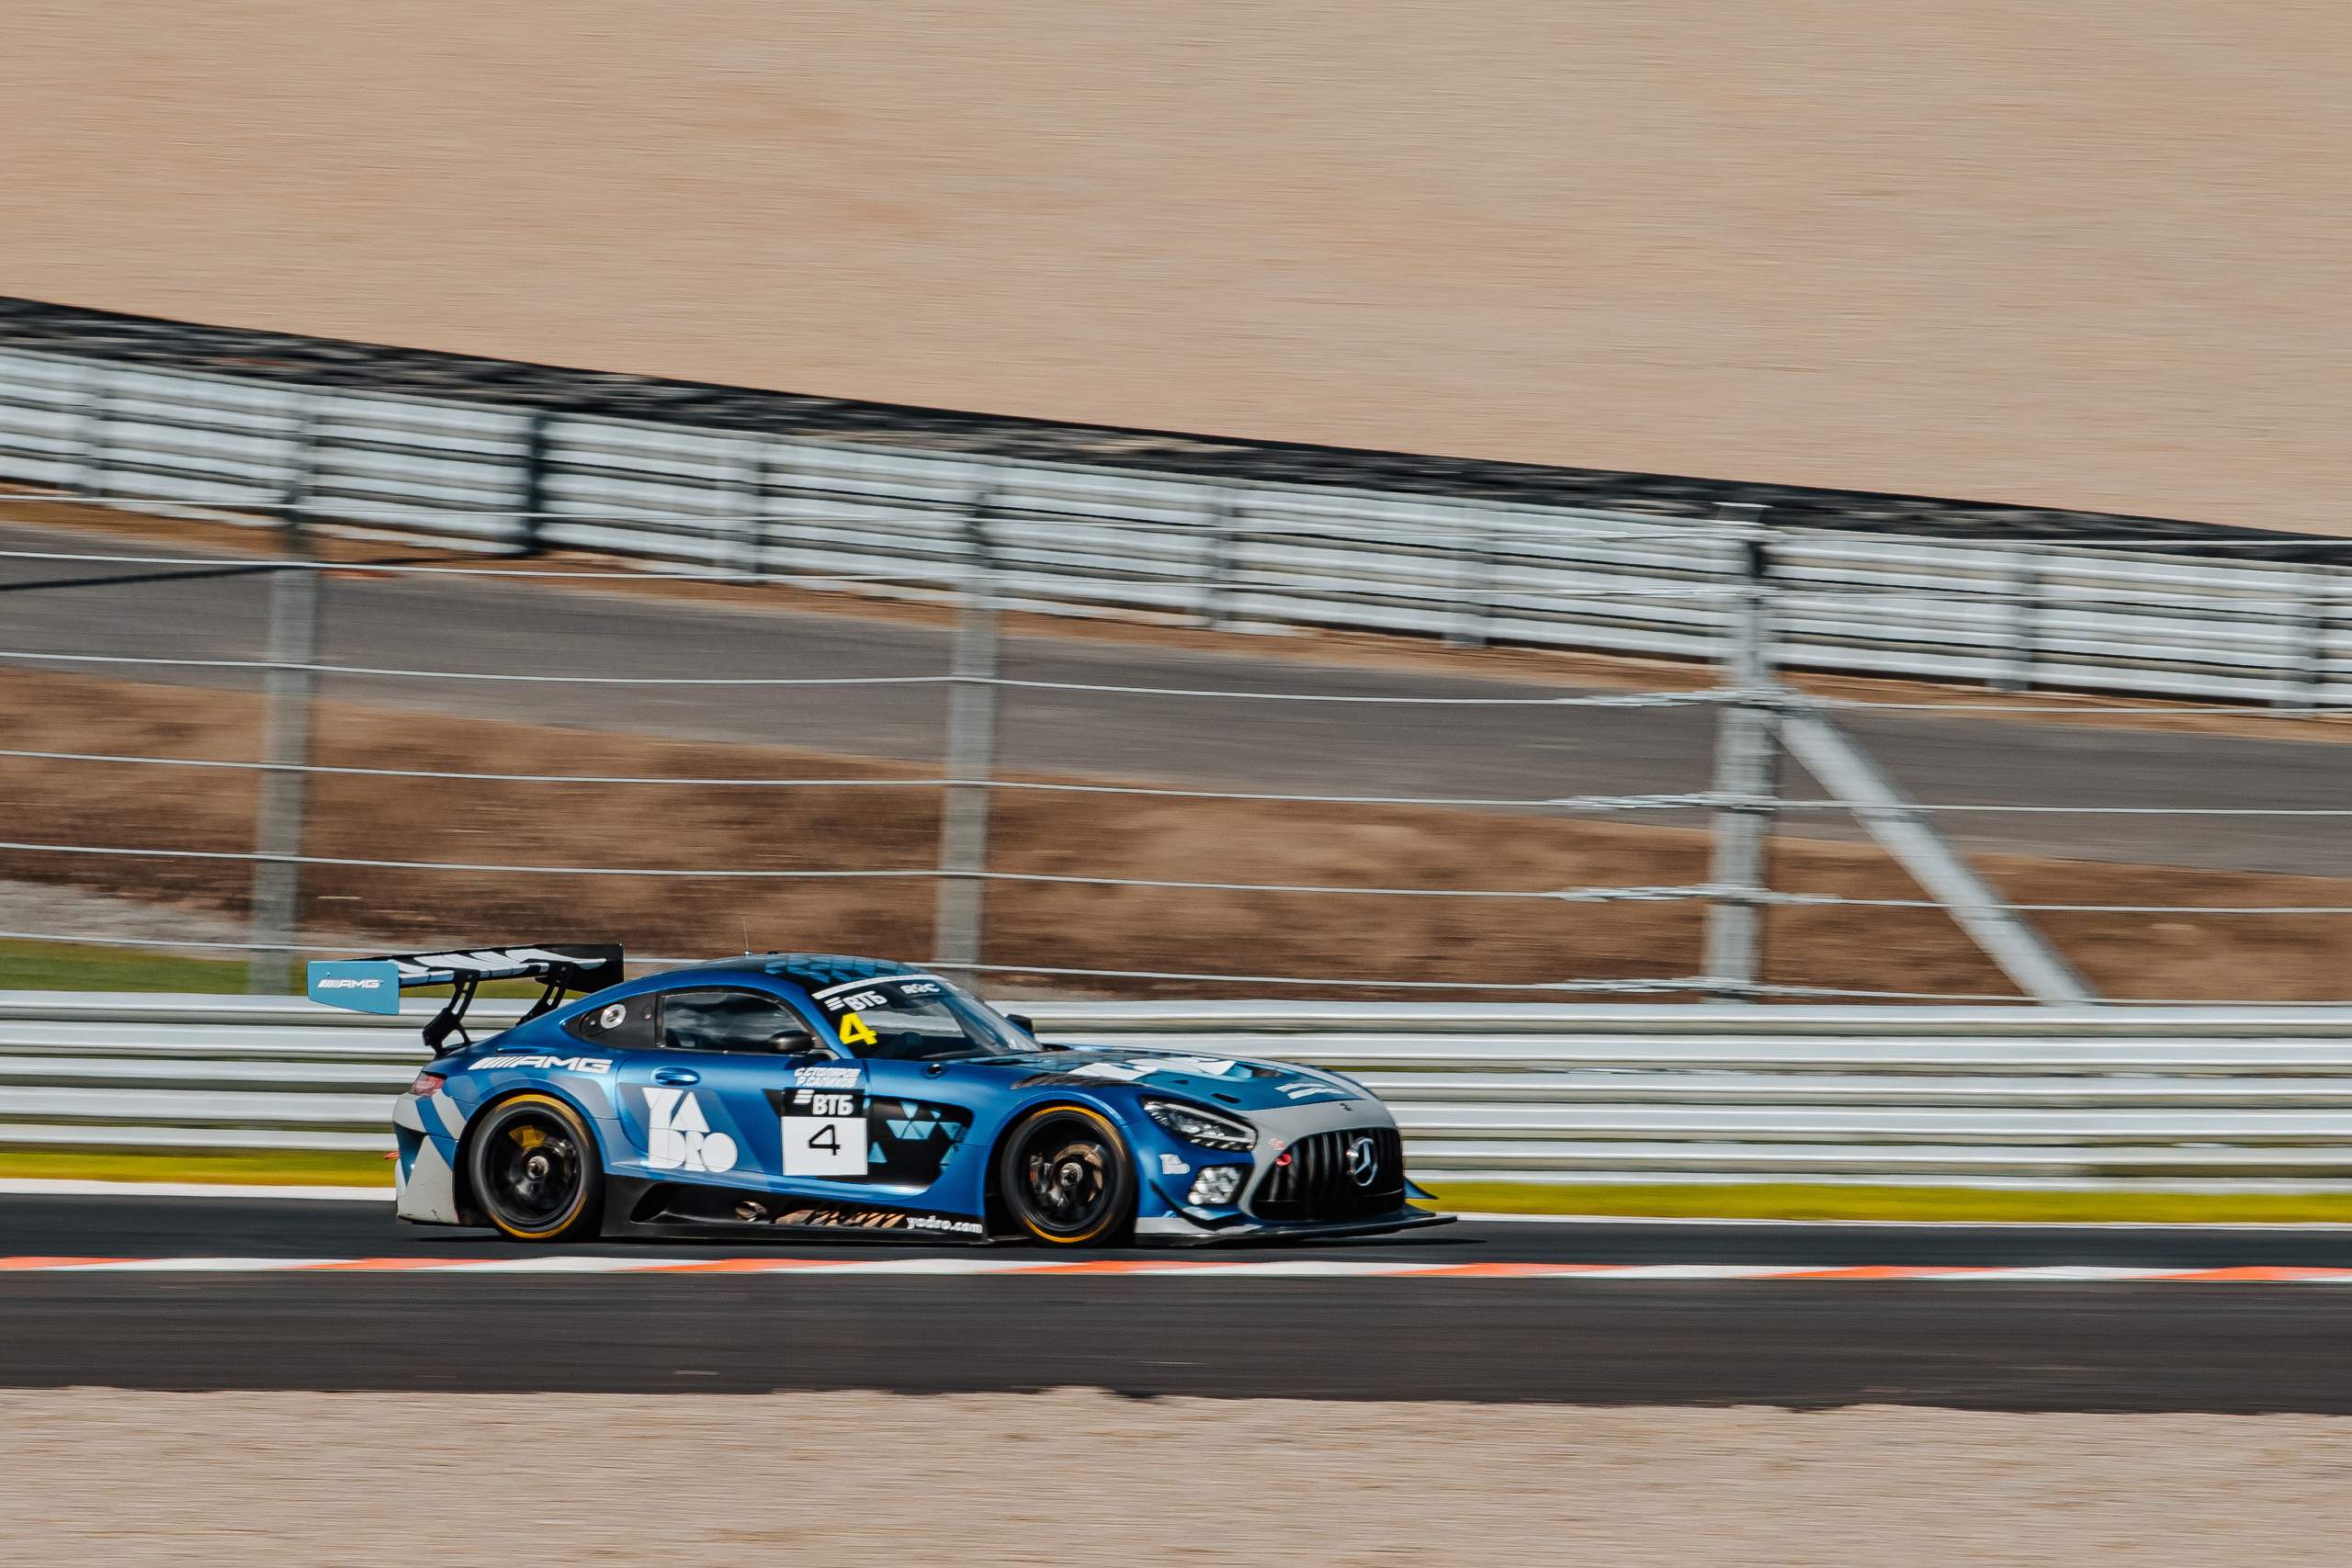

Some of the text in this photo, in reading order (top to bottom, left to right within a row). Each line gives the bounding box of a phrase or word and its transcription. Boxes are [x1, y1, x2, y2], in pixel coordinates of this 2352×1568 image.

[338, 979, 381, 988] AMG
[842, 990, 888, 1011] ВТБ
[839, 1012, 877, 1045] 4
[513, 1055, 614, 1075] AMG
[812, 1094, 854, 1115] ВТБ
[808, 1123, 842, 1156] 4
[906, 1214, 983, 1234] yadro.com
